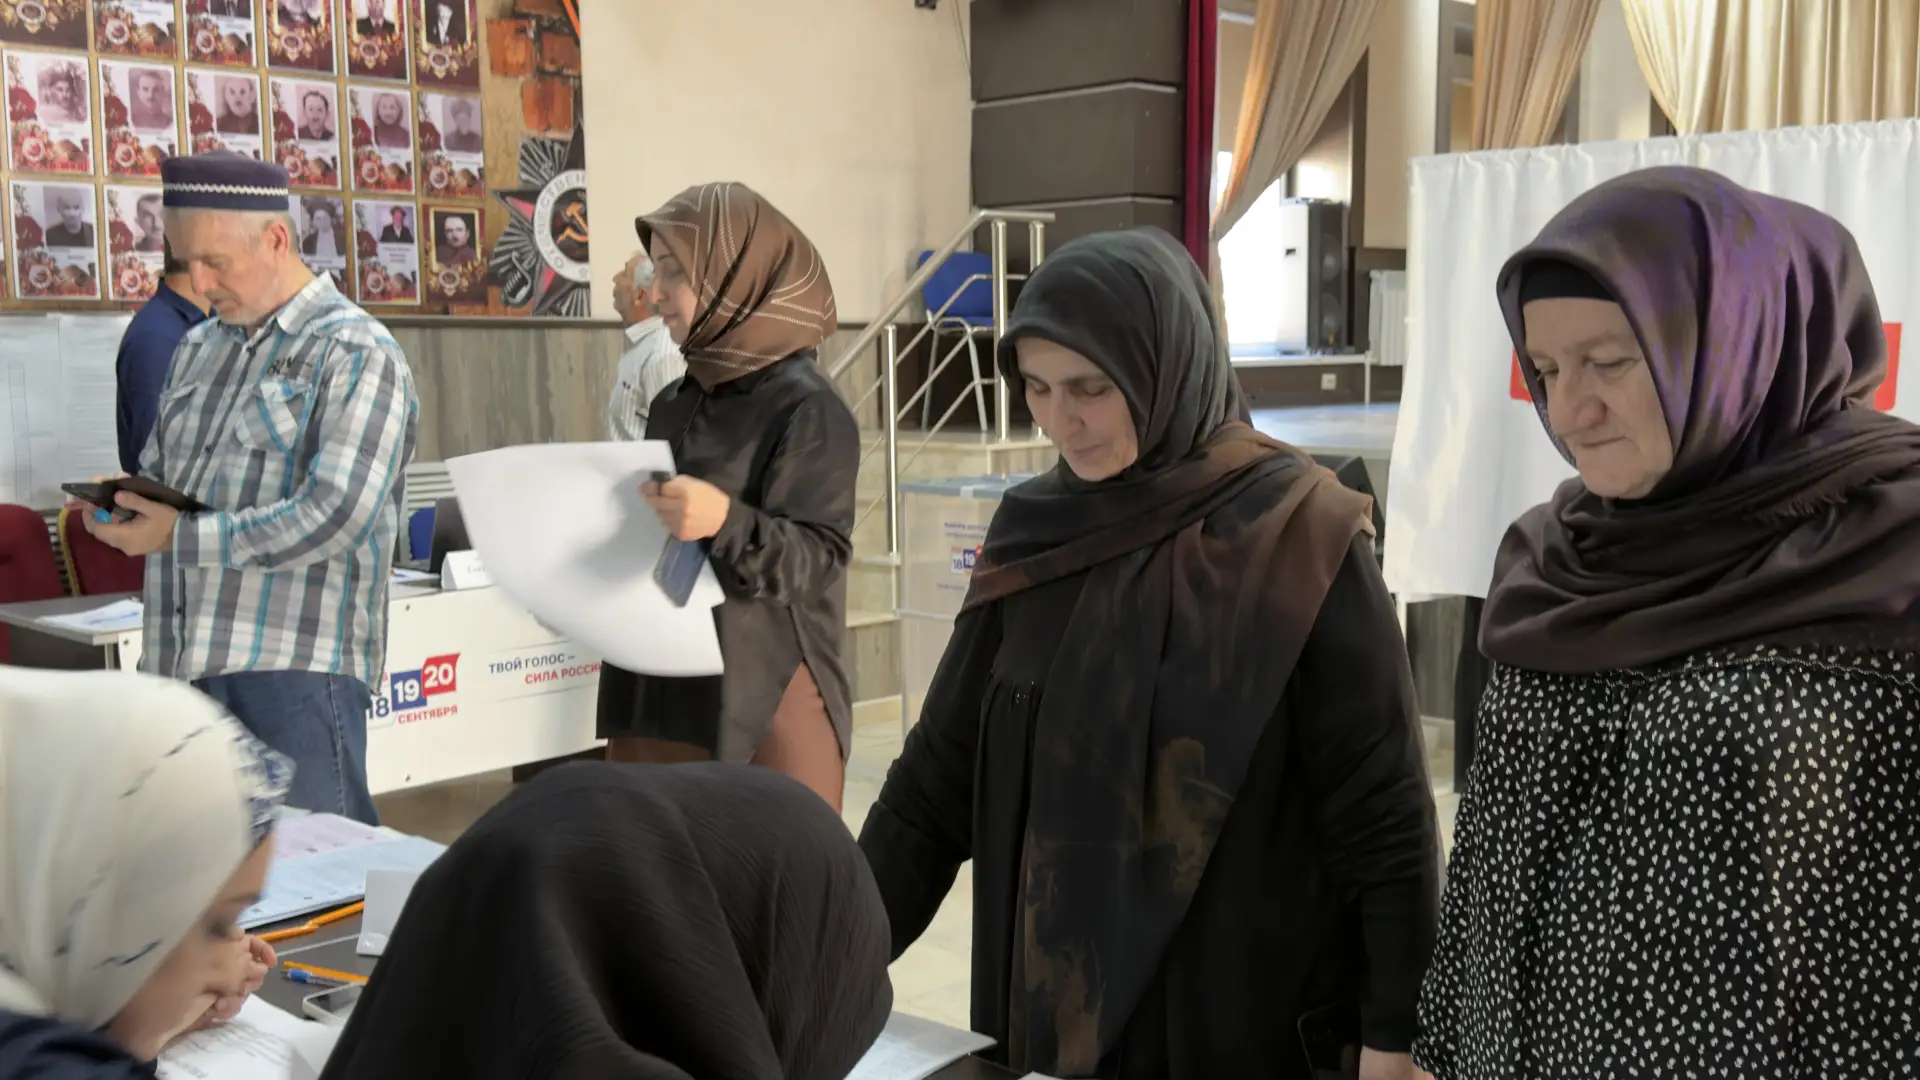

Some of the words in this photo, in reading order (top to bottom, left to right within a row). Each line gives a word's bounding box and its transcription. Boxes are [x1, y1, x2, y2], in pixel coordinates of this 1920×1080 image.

[488, 657, 522, 674] ТВОЙ
[524, 653, 566, 668] ГОЛОС
[525, 669, 558, 684] СИЛА
[560, 662, 600, 679] РОССИ
[394, 678, 420, 704] 19
[423, 662, 454, 688] 20
[397, 705, 458, 724] СЕНТЯБРЯ
